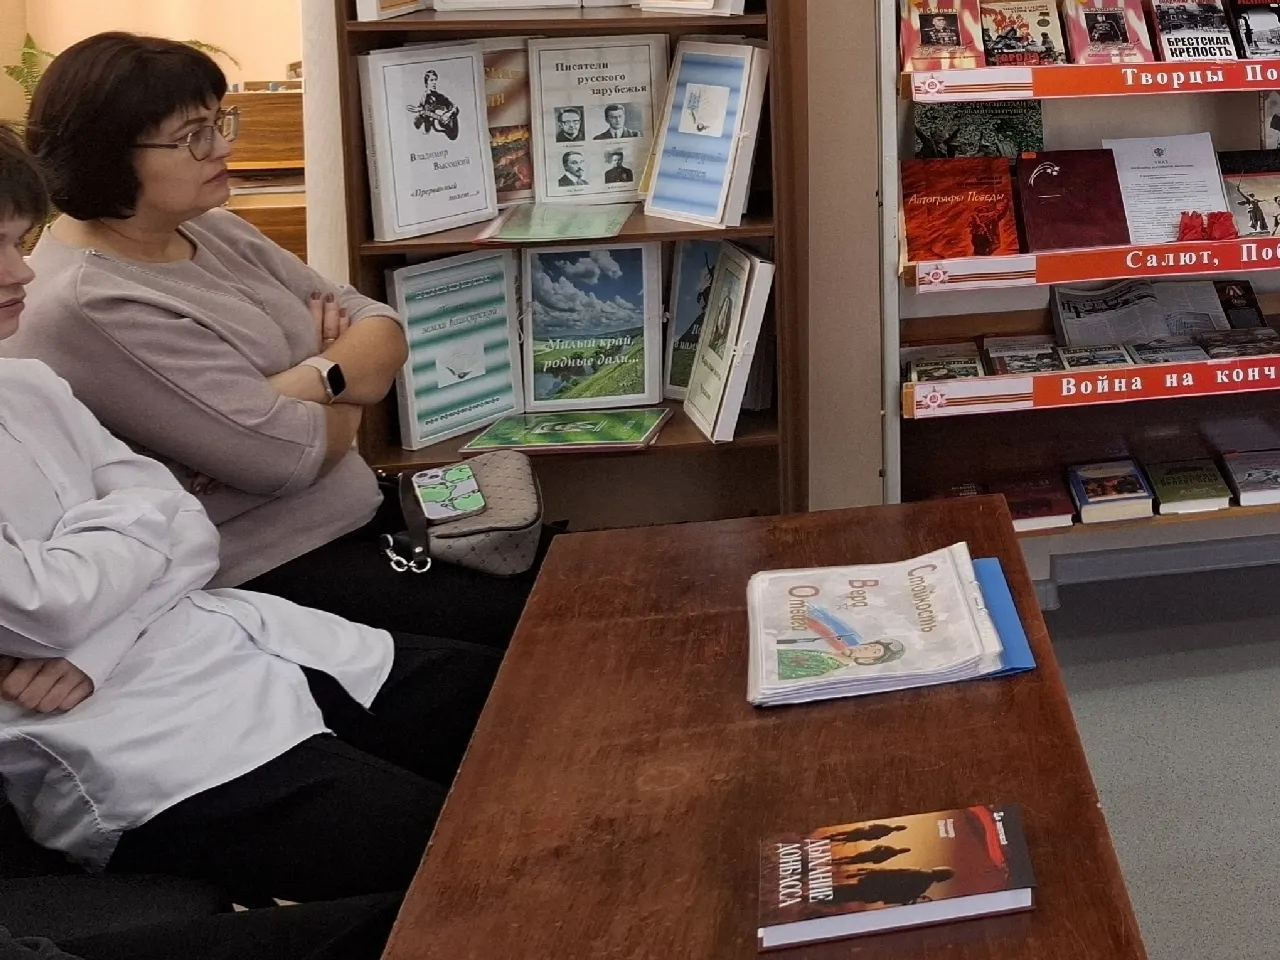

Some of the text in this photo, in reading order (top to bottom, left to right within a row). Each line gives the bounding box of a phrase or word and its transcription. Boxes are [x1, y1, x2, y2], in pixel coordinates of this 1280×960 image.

[1166, 36, 1231, 47] БРЕСТСКАЯ
[1170, 46, 1233, 58] КРЕПОСТЬ
[555, 61, 609, 72] Писатели
[577, 73, 626, 86] русского
[1121, 66, 1225, 89] Творцы
[590, 84, 648, 97] зарубежья
[908, 192, 1005, 207] Автографы Победы
[1126, 248, 1220, 270] Салют,
[548, 336, 635, 353] Милый край,
[543, 355, 594, 372] родные
[1060, 371, 1143, 396] Война
[1165, 372, 1195, 388] на
[848, 578, 880, 609] Вера
[907, 563, 939, 634] Стойкость
[787, 584, 821, 632] Отвага
[778, 842, 802, 908] ДОНБАССА
[804, 838, 834, 905] ДЫХАНИЕ
